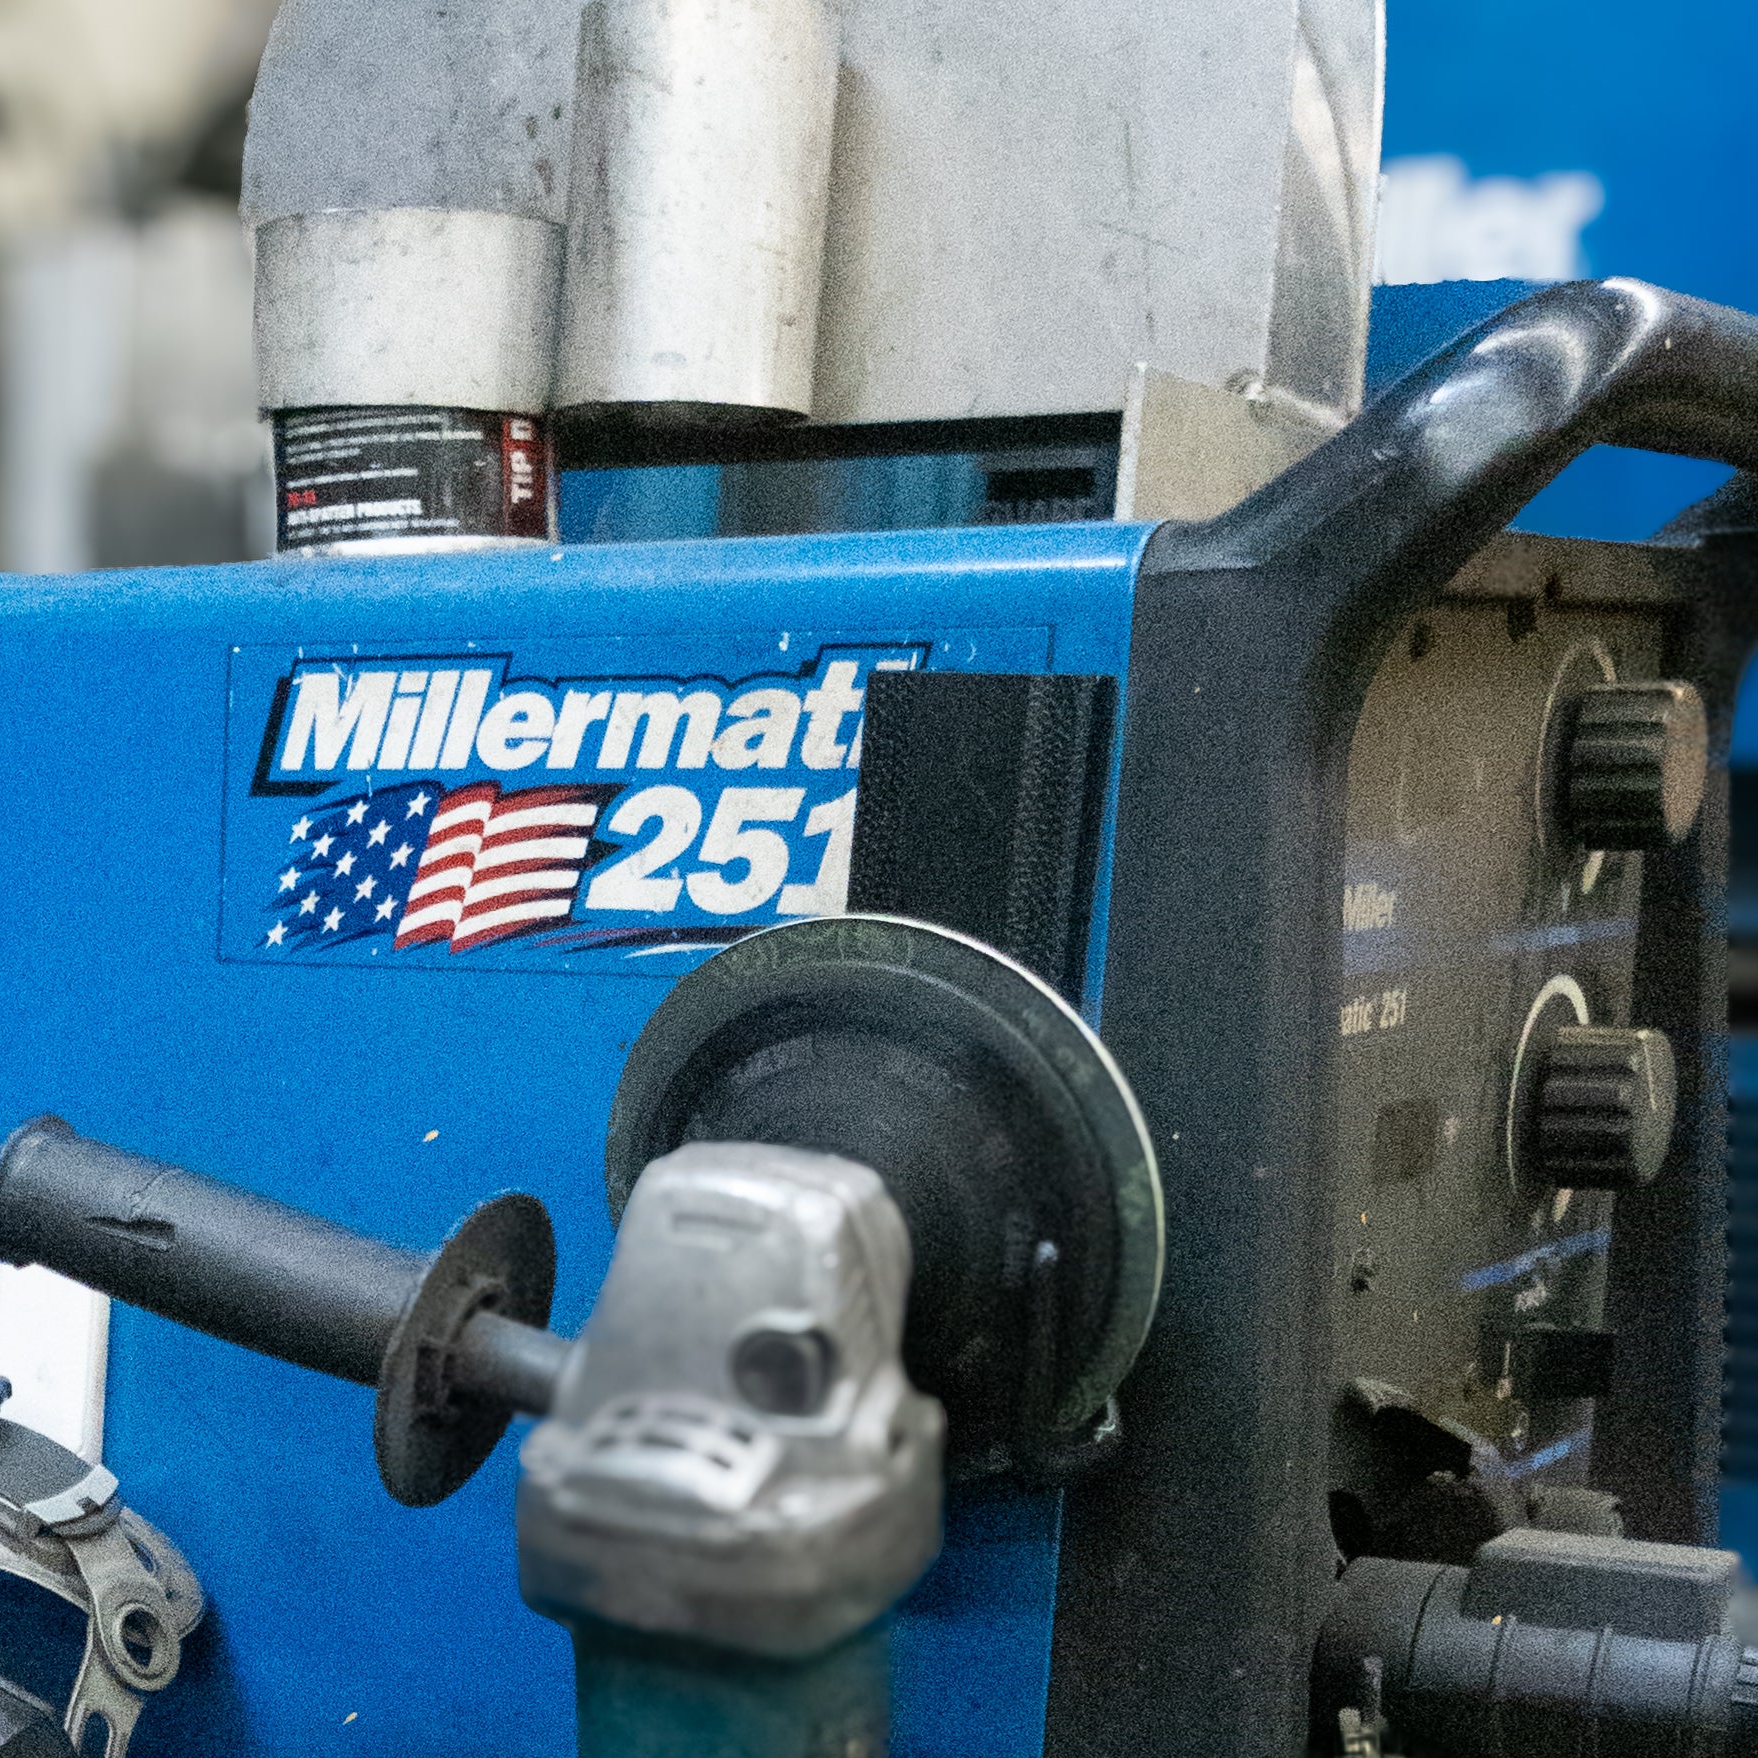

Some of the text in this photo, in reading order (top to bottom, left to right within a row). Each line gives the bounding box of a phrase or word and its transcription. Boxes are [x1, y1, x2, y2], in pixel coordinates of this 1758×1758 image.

[509, 450, 534, 503] TIP
[280, 660, 909, 772] Millermat
[584, 785, 858, 917] 251
